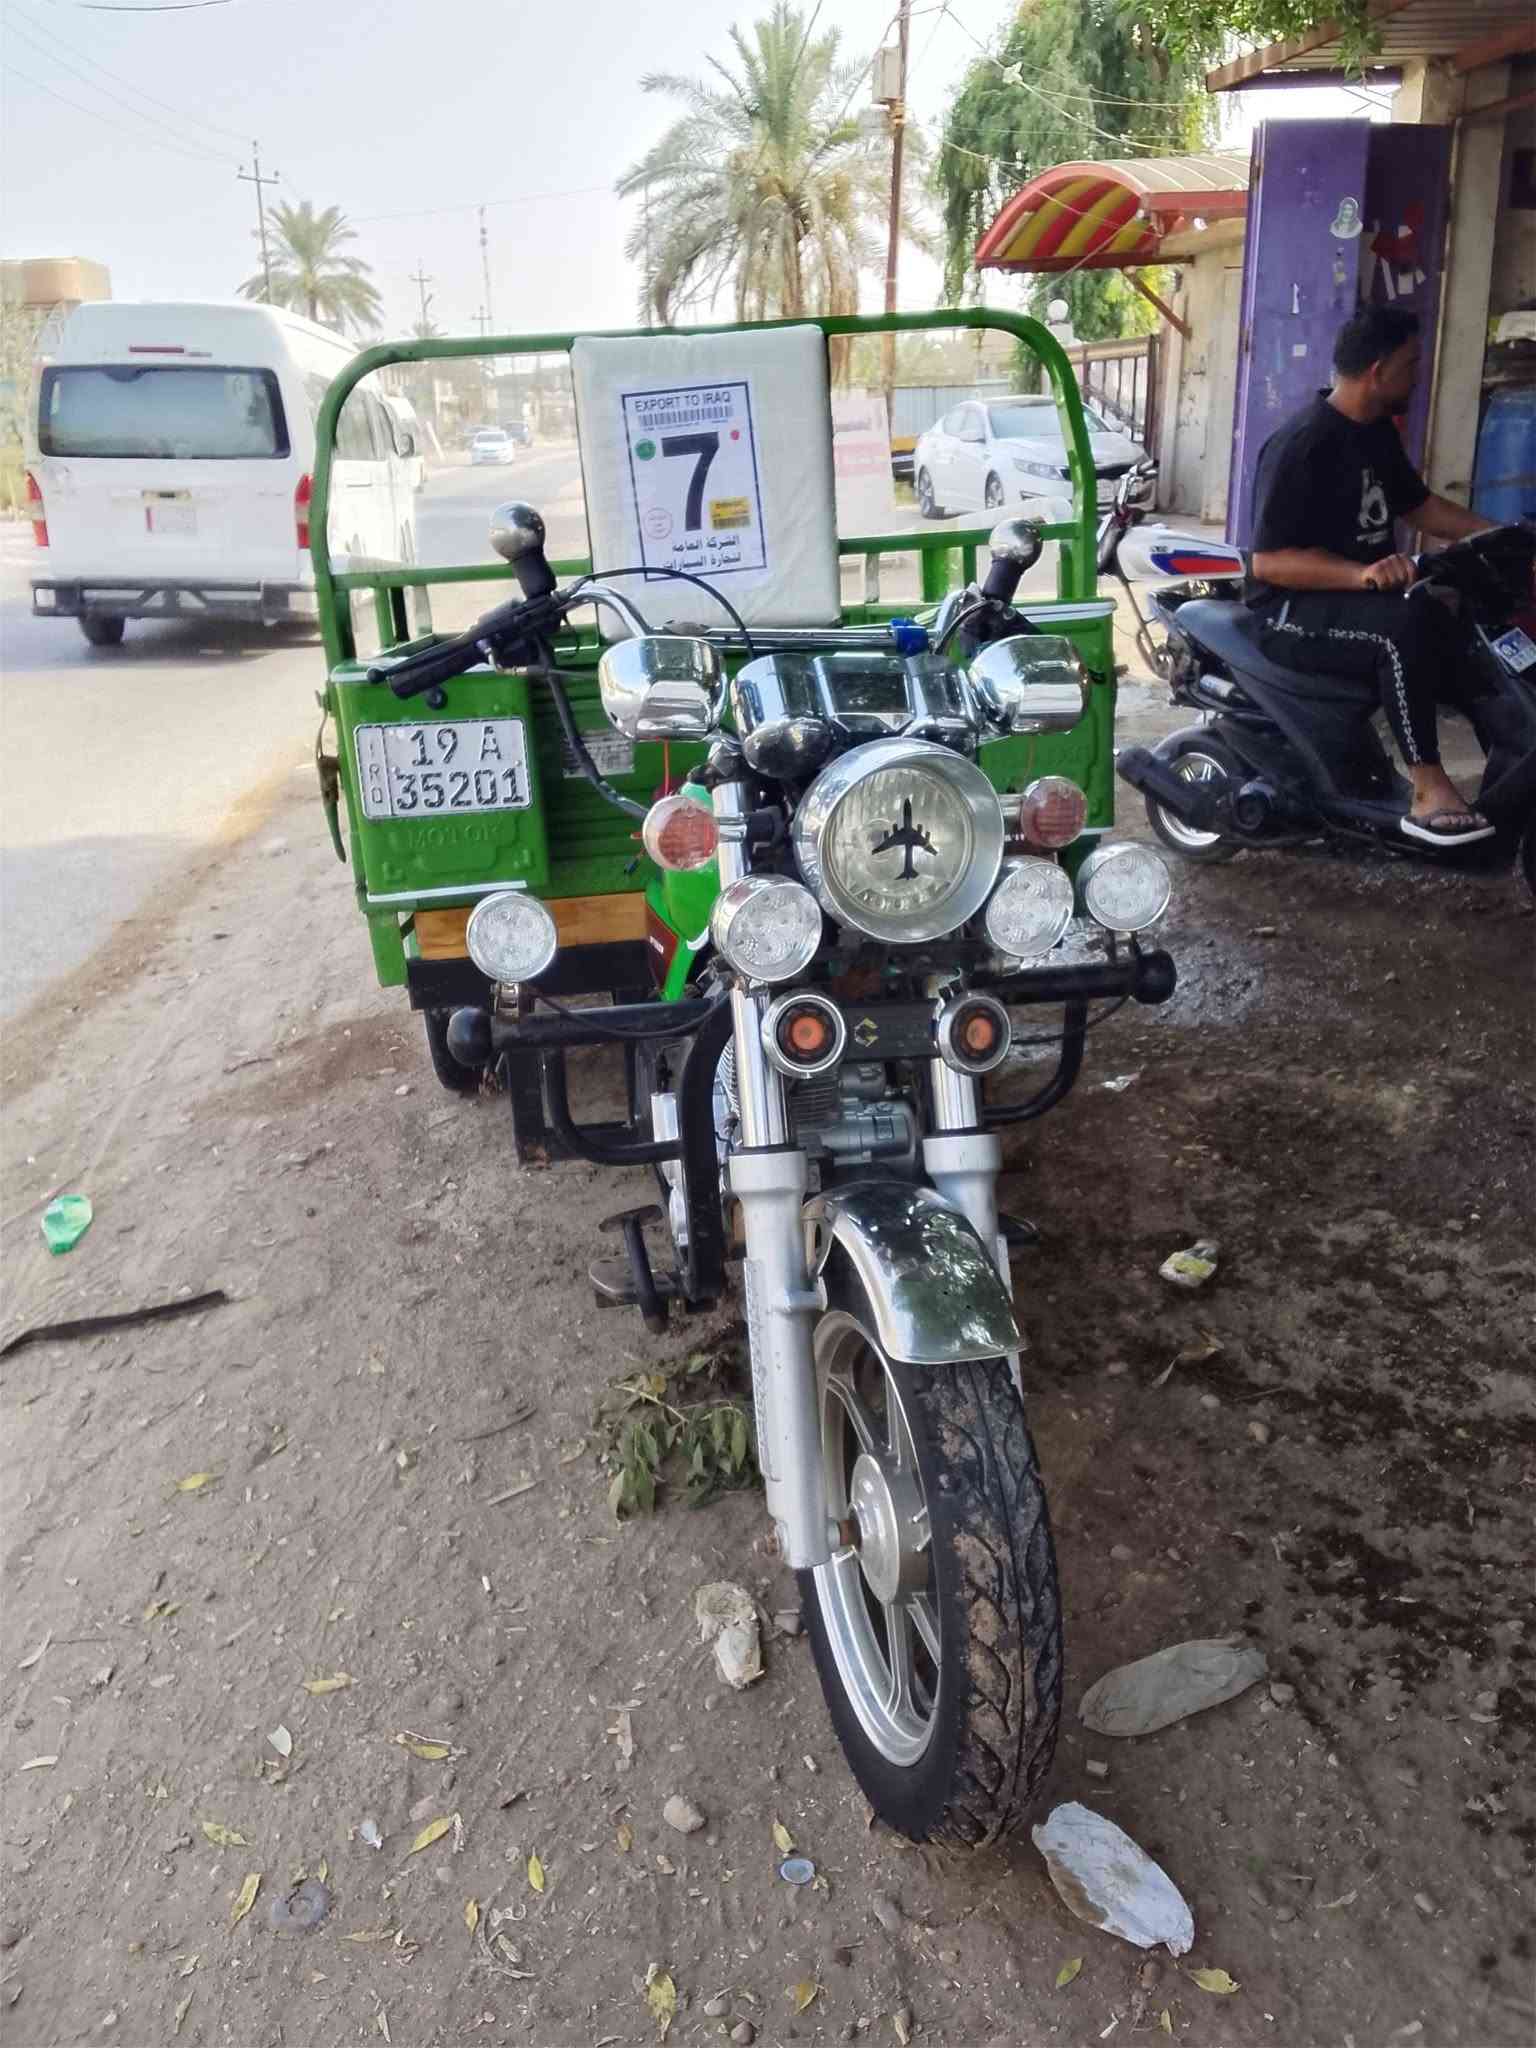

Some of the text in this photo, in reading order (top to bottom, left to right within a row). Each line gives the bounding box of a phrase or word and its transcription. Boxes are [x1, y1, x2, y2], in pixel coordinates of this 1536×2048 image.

[635, 390, 732, 413] EXPORT TO IRAQ
[661, 431, 720, 532] 7
[410, 725, 502, 767] 19 A
[396, 767, 525, 811] 35201
